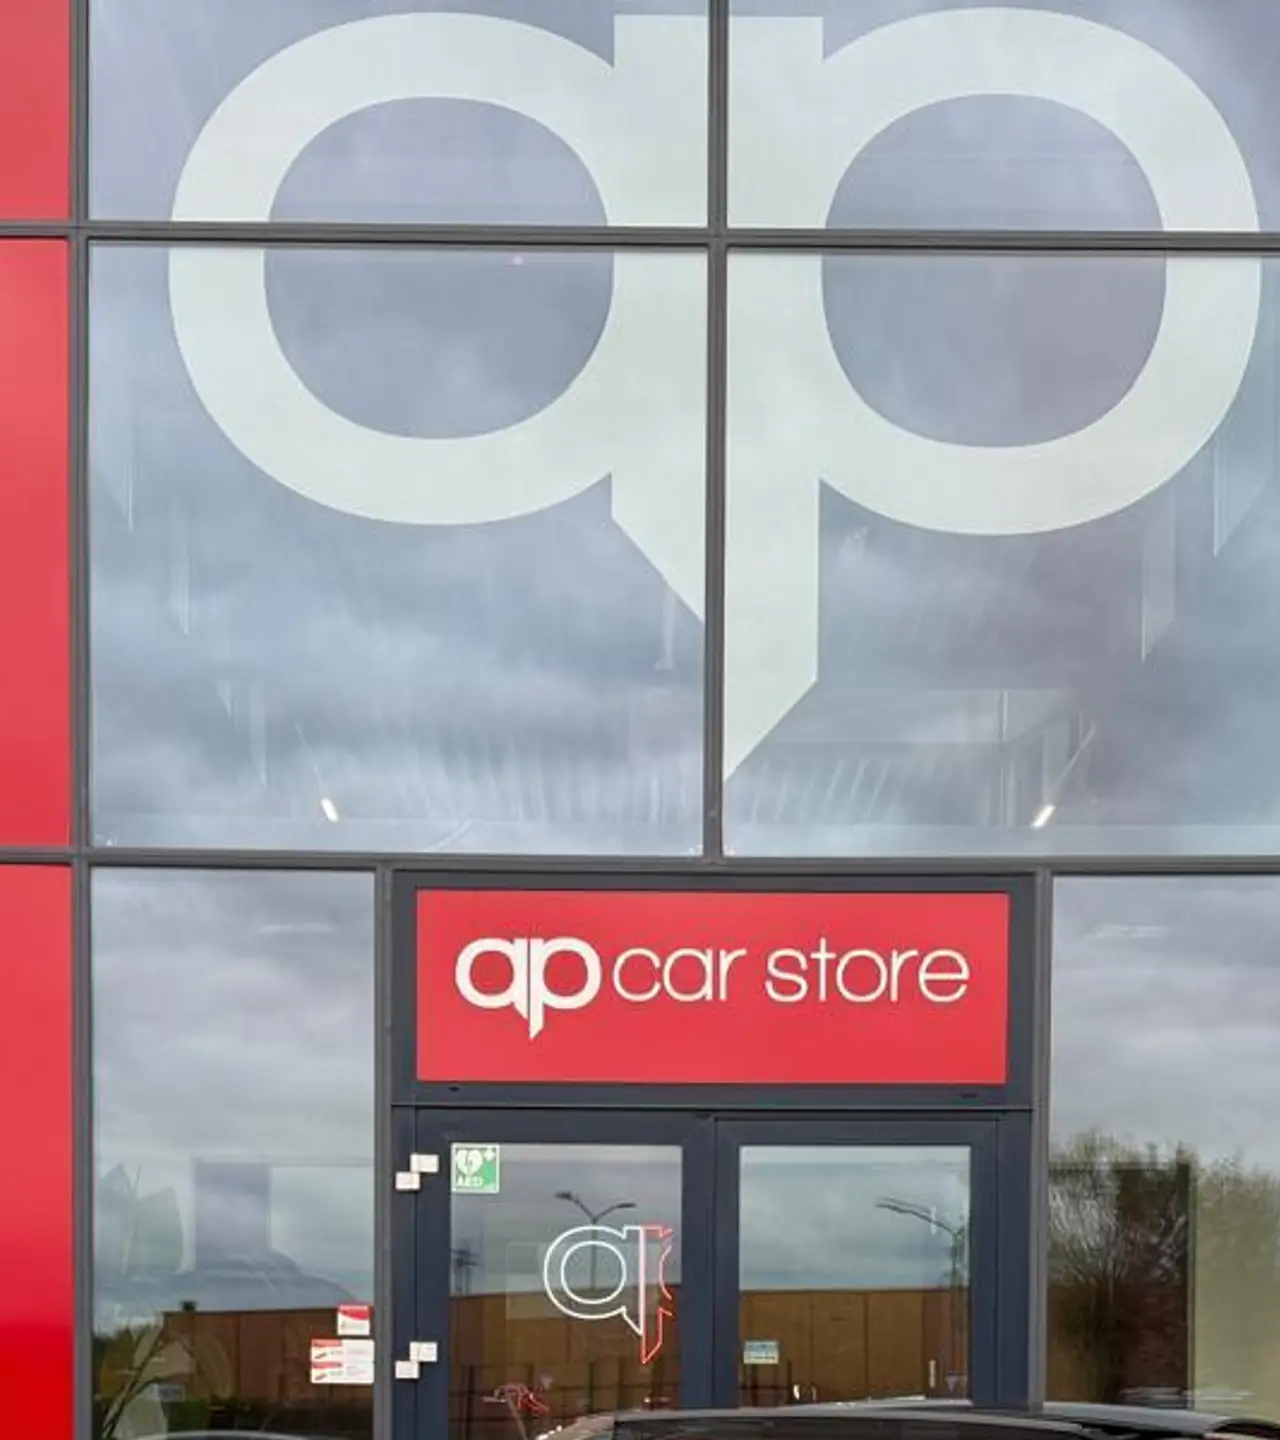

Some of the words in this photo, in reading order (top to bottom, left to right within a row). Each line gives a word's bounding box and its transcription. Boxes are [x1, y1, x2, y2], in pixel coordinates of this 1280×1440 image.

[168, 7, 1260, 782] ap
[454, 937, 602, 1040] ap
[613, 947, 747, 1002] car
[765, 938, 970, 1002] store
